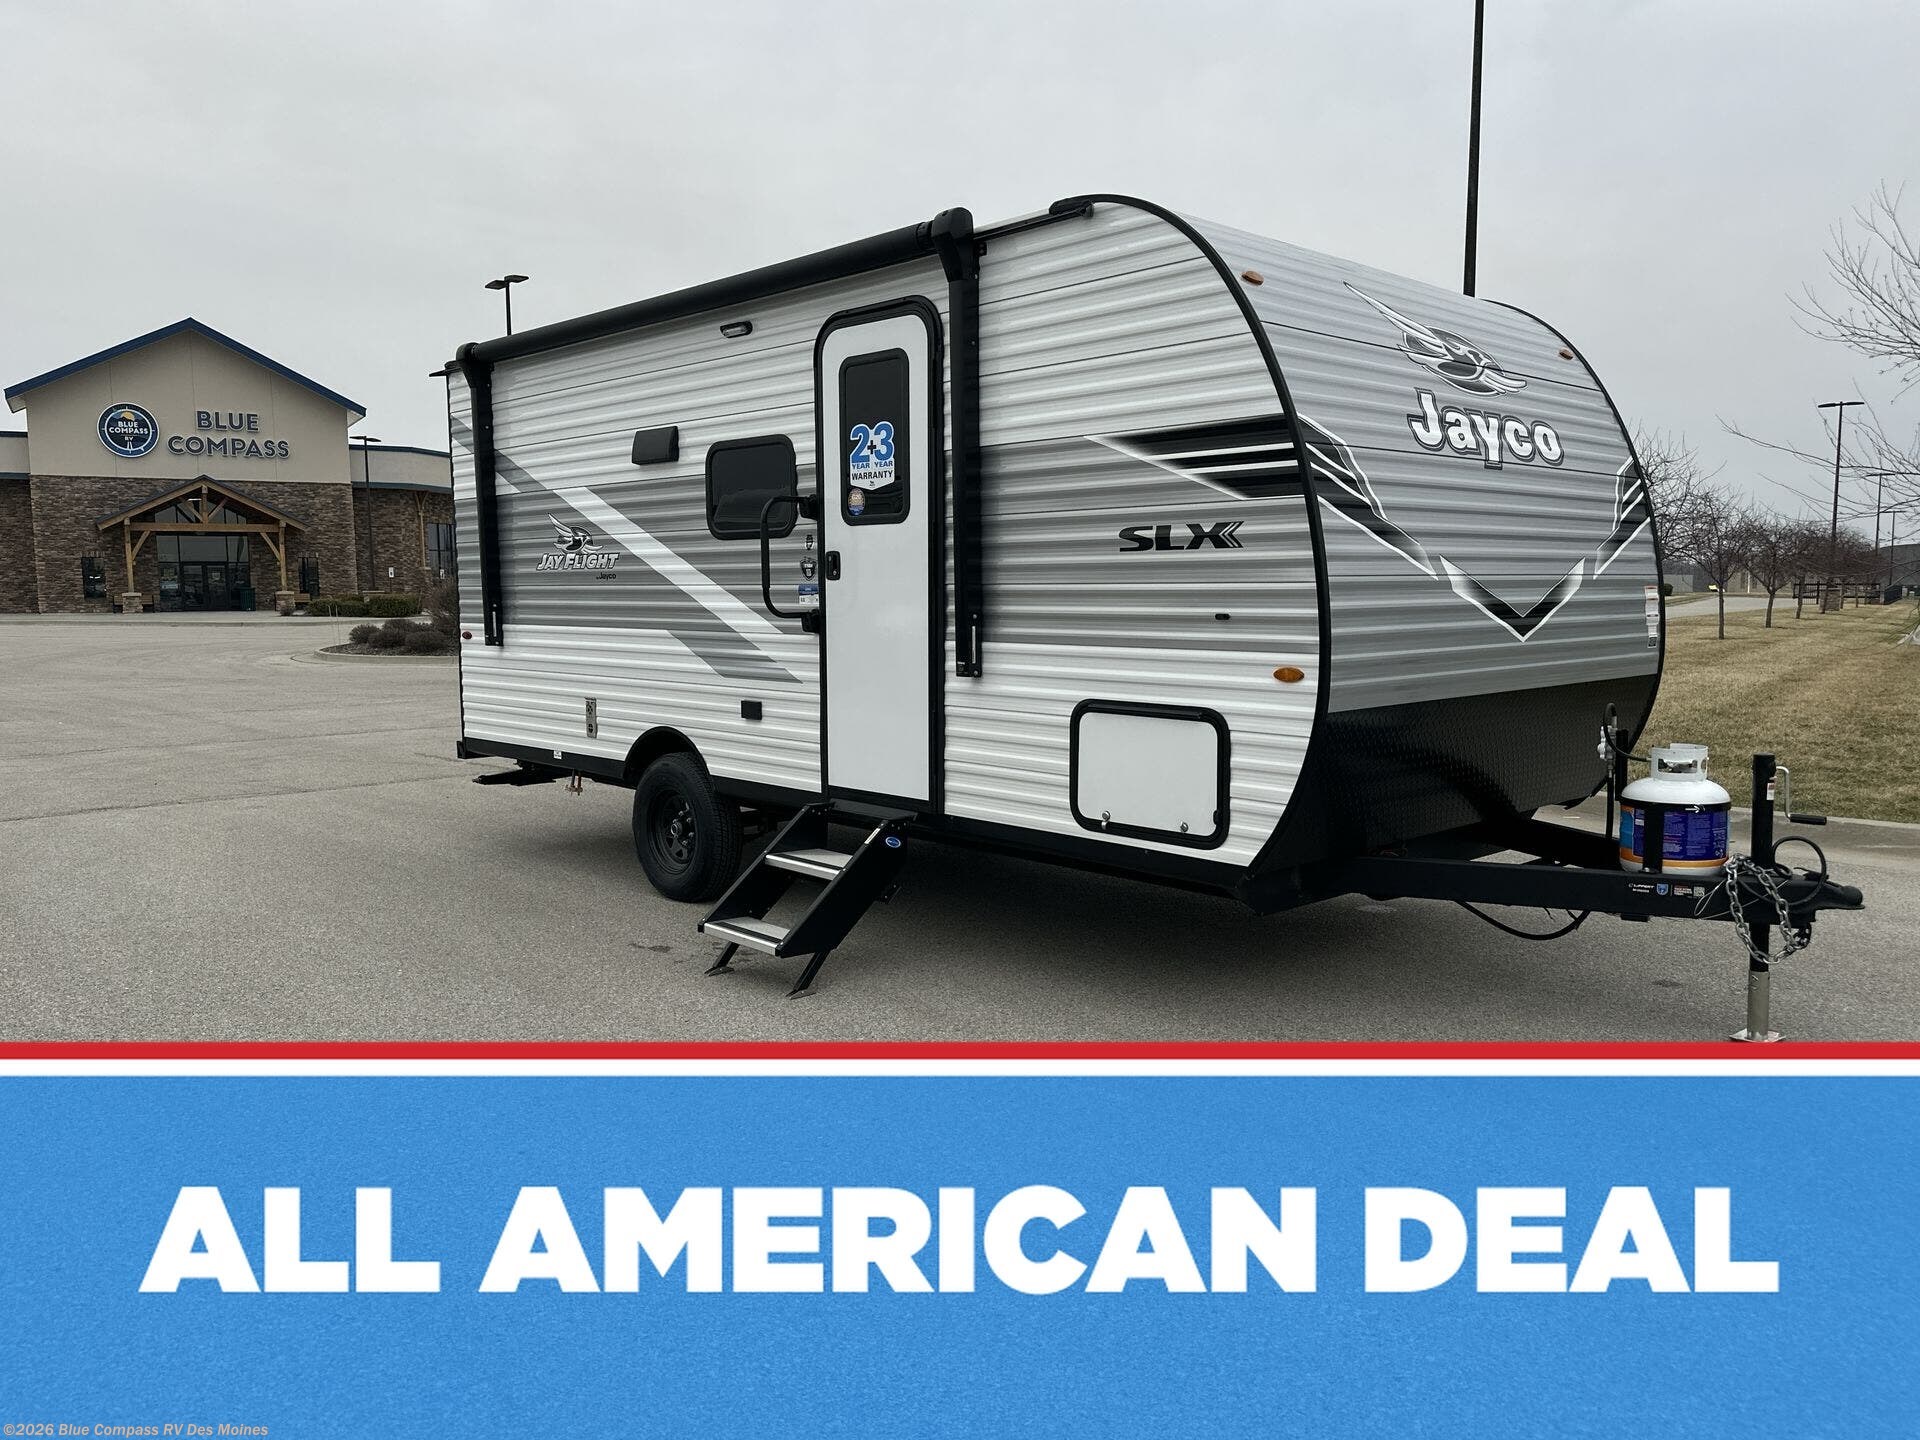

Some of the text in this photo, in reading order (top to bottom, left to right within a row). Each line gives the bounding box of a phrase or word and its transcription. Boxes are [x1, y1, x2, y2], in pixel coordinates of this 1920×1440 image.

[196, 410, 260, 432] BLUE
[1407, 388, 1565, 469] Jayco
[108, 427, 149, 435] COMPASS
[167, 435, 290, 459] COMPASS
[852, 460, 893, 470] YEAR YEAR
[851, 470, 893, 481] WARRANTY
[1119, 522, 1238, 553] SLX
[536, 553, 619, 570] JAY FLIGHT
[599, 572, 617, 581] Jayco
